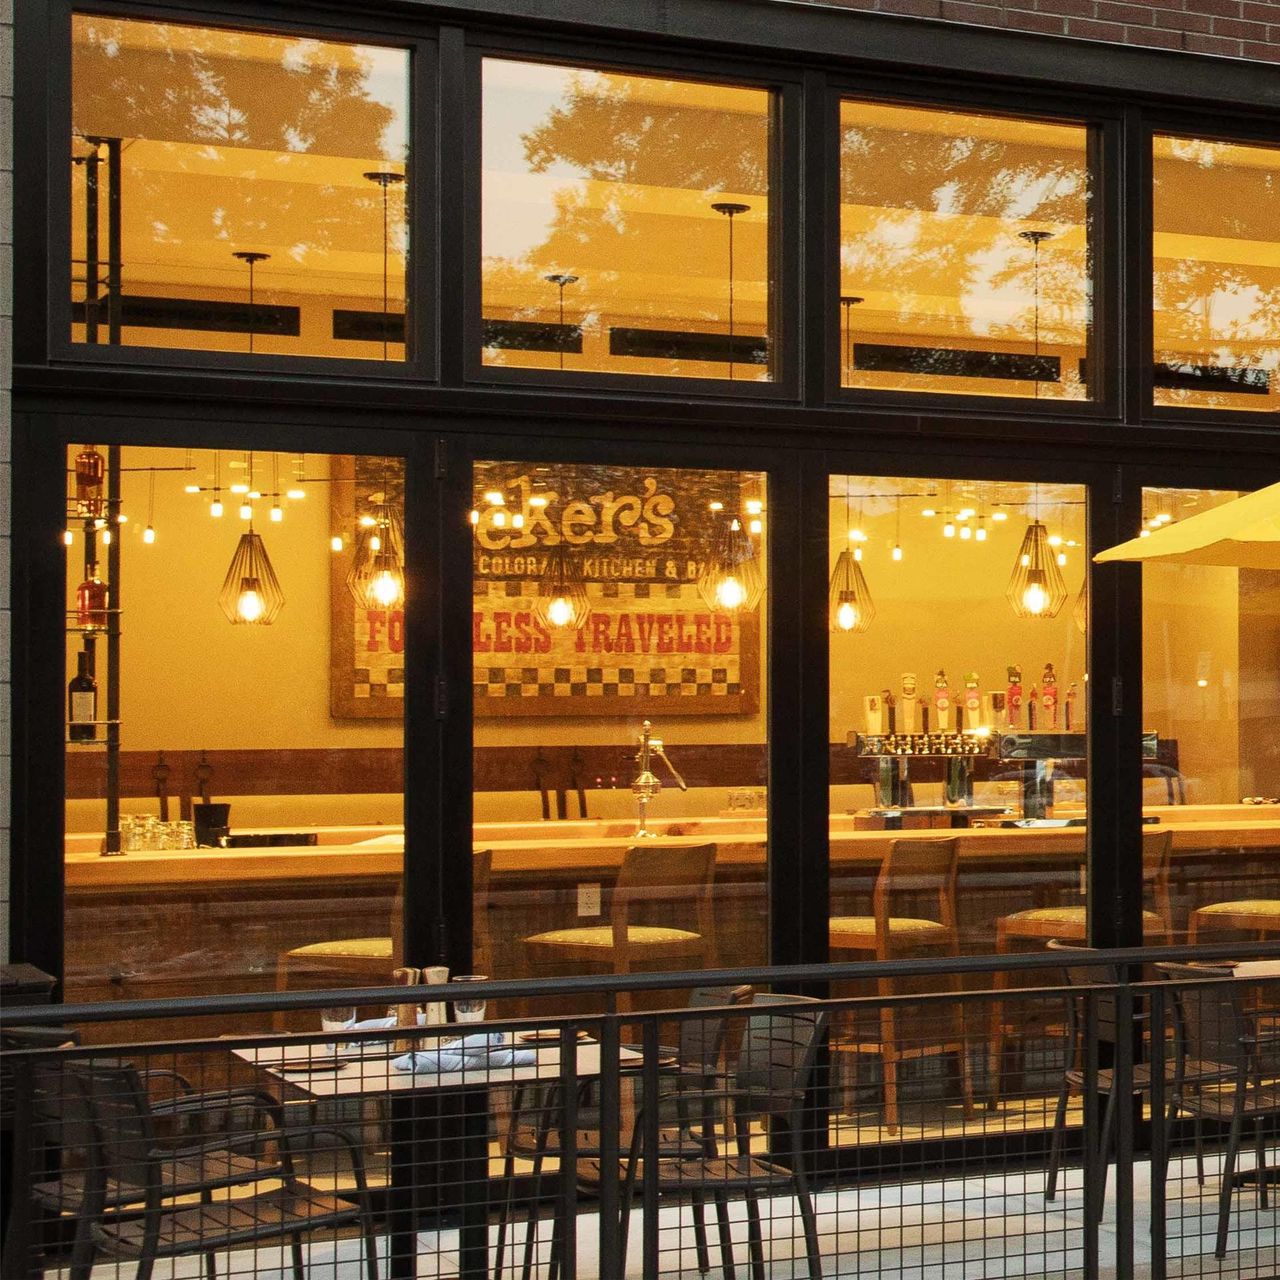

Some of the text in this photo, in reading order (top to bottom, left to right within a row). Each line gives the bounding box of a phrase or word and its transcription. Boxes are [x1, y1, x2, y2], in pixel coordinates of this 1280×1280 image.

[583, 557, 656, 578] KITCHEN
[665, 559, 678, 578] &
[473, 611, 551, 653] LESS
[574, 612, 733, 654] TRAVELED
